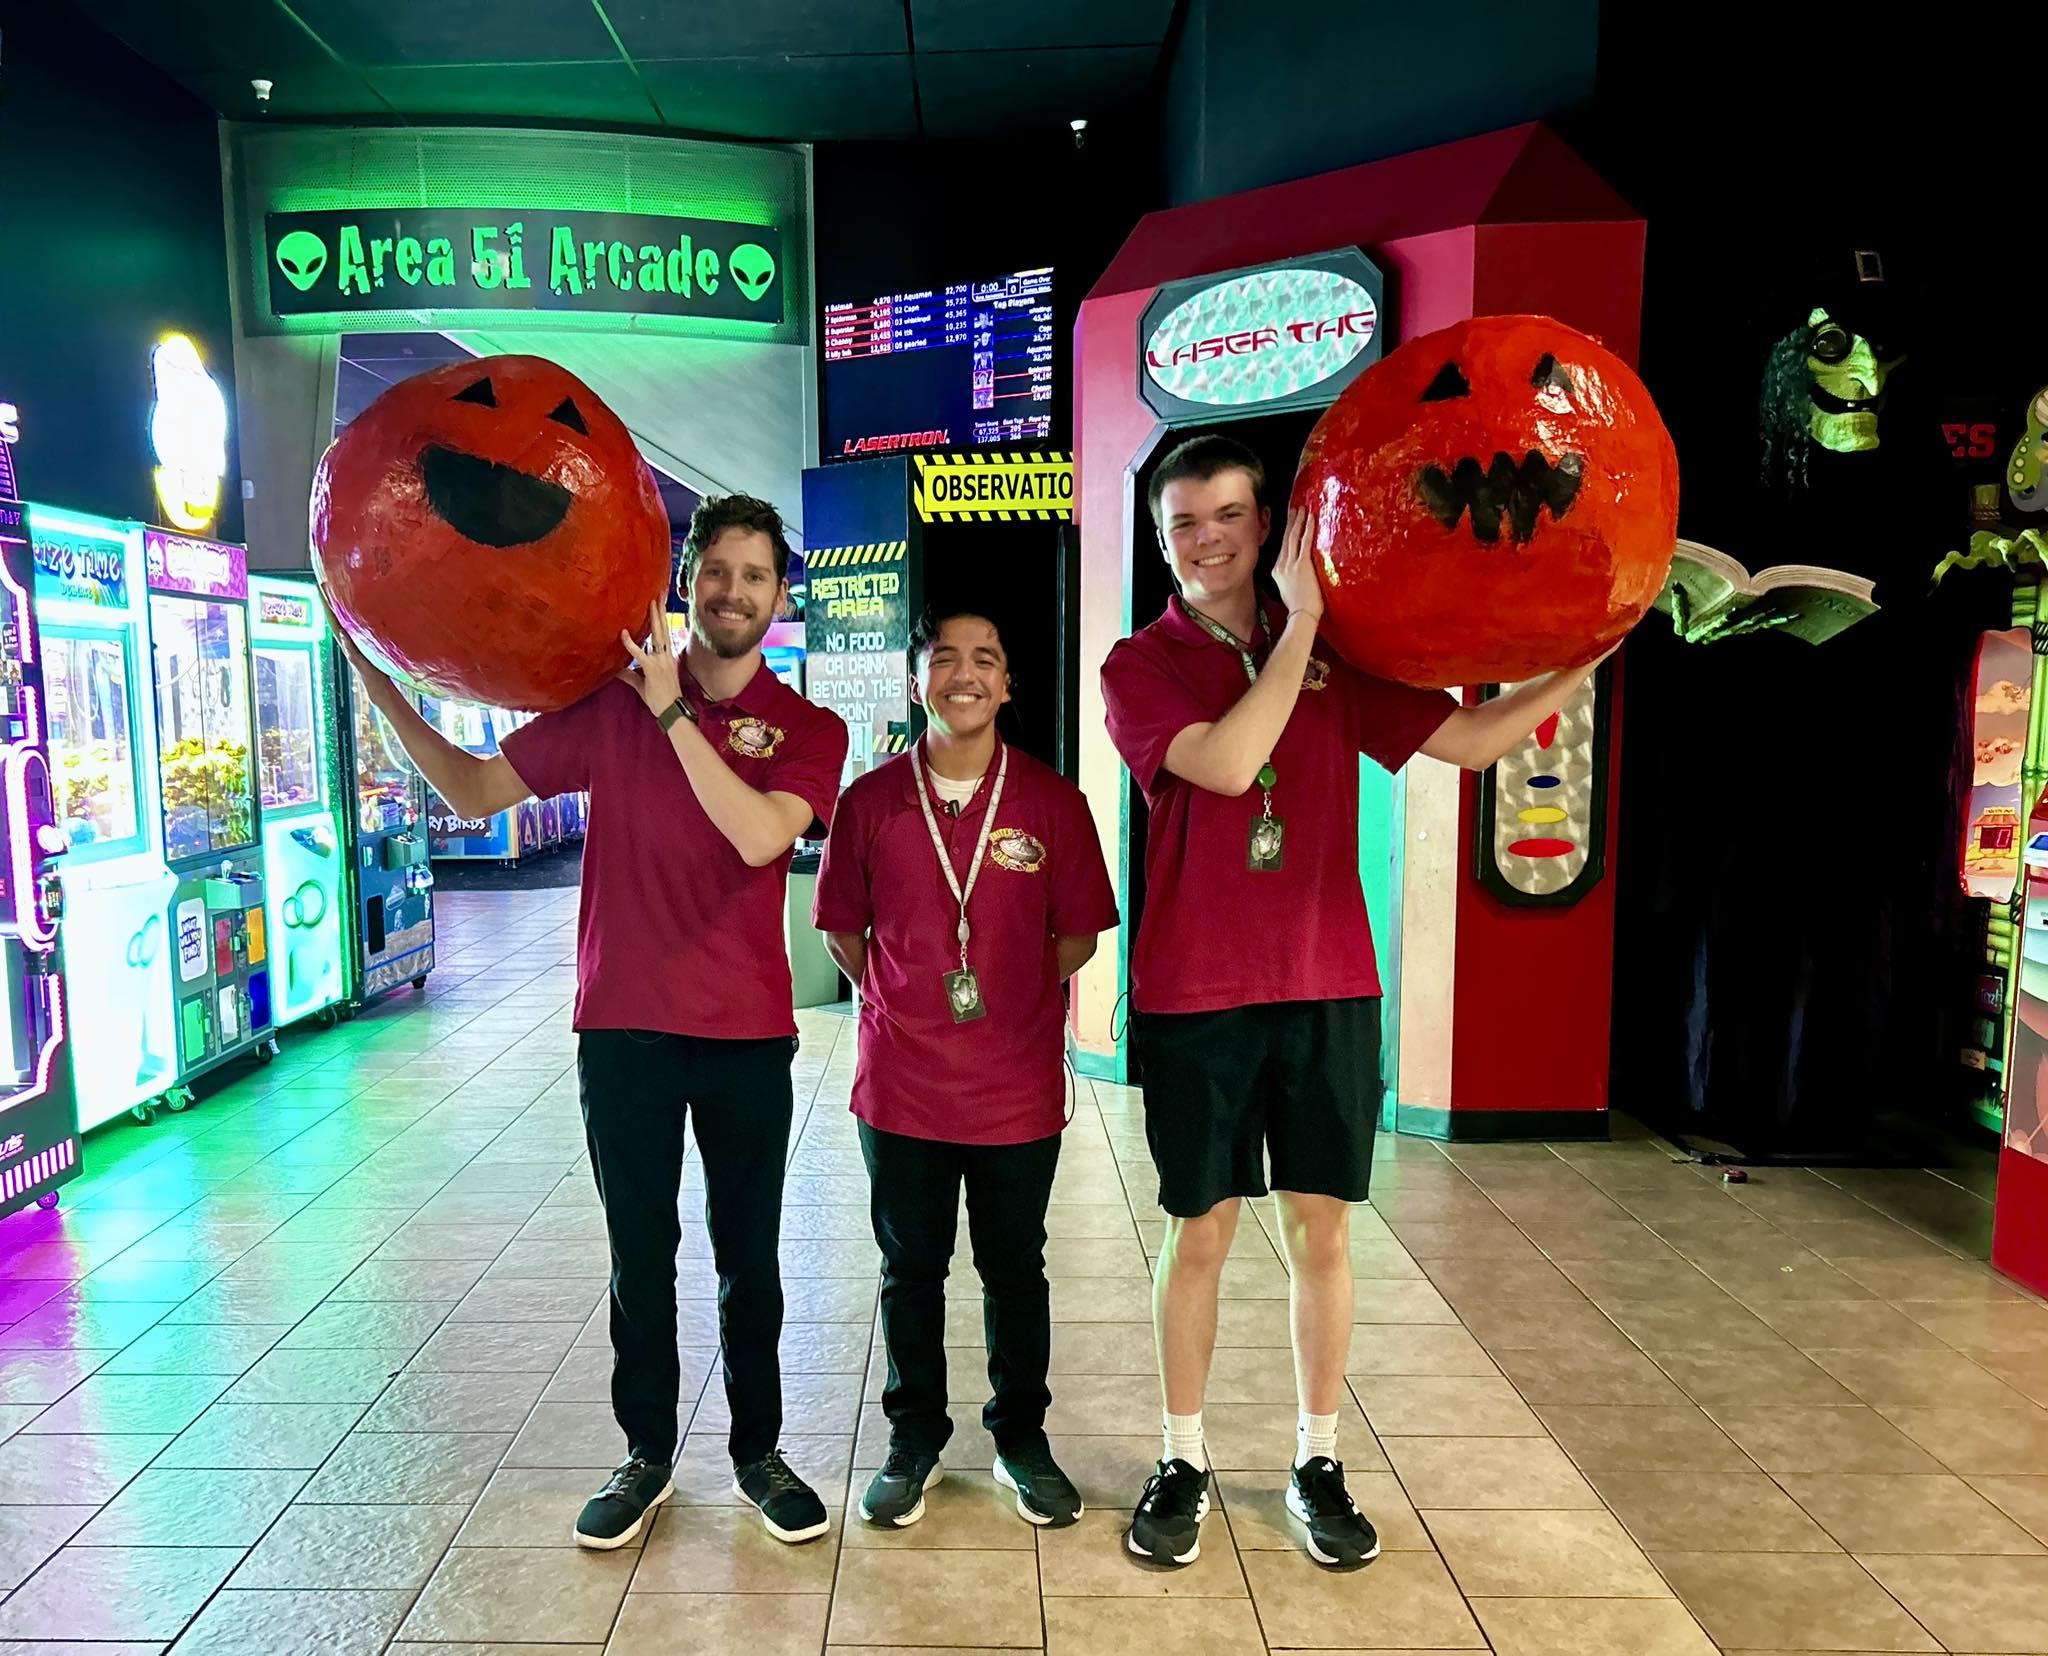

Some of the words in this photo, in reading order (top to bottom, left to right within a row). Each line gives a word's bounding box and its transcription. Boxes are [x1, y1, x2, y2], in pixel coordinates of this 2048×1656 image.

[338, 224, 456, 296] Area
[471, 222, 532, 290] 51
[549, 225, 720, 299] Arcade
[1147, 328, 1279, 368] LASER
[1286, 310, 1374, 344] TAG
[844, 429, 948, 454] LASERTRON
[811, 572, 900, 602] RESTRICTED
[827, 596, 884, 620] AREA
[826, 632, 845, 652] NO
[849, 631, 886, 653] FOOD
[825, 657, 844, 677] OR
[848, 653, 888, 677] DRINK
[812, 678, 866, 700] BEYOND
[870, 676, 902, 699] THIS
[837, 701, 878, 722] POINT
